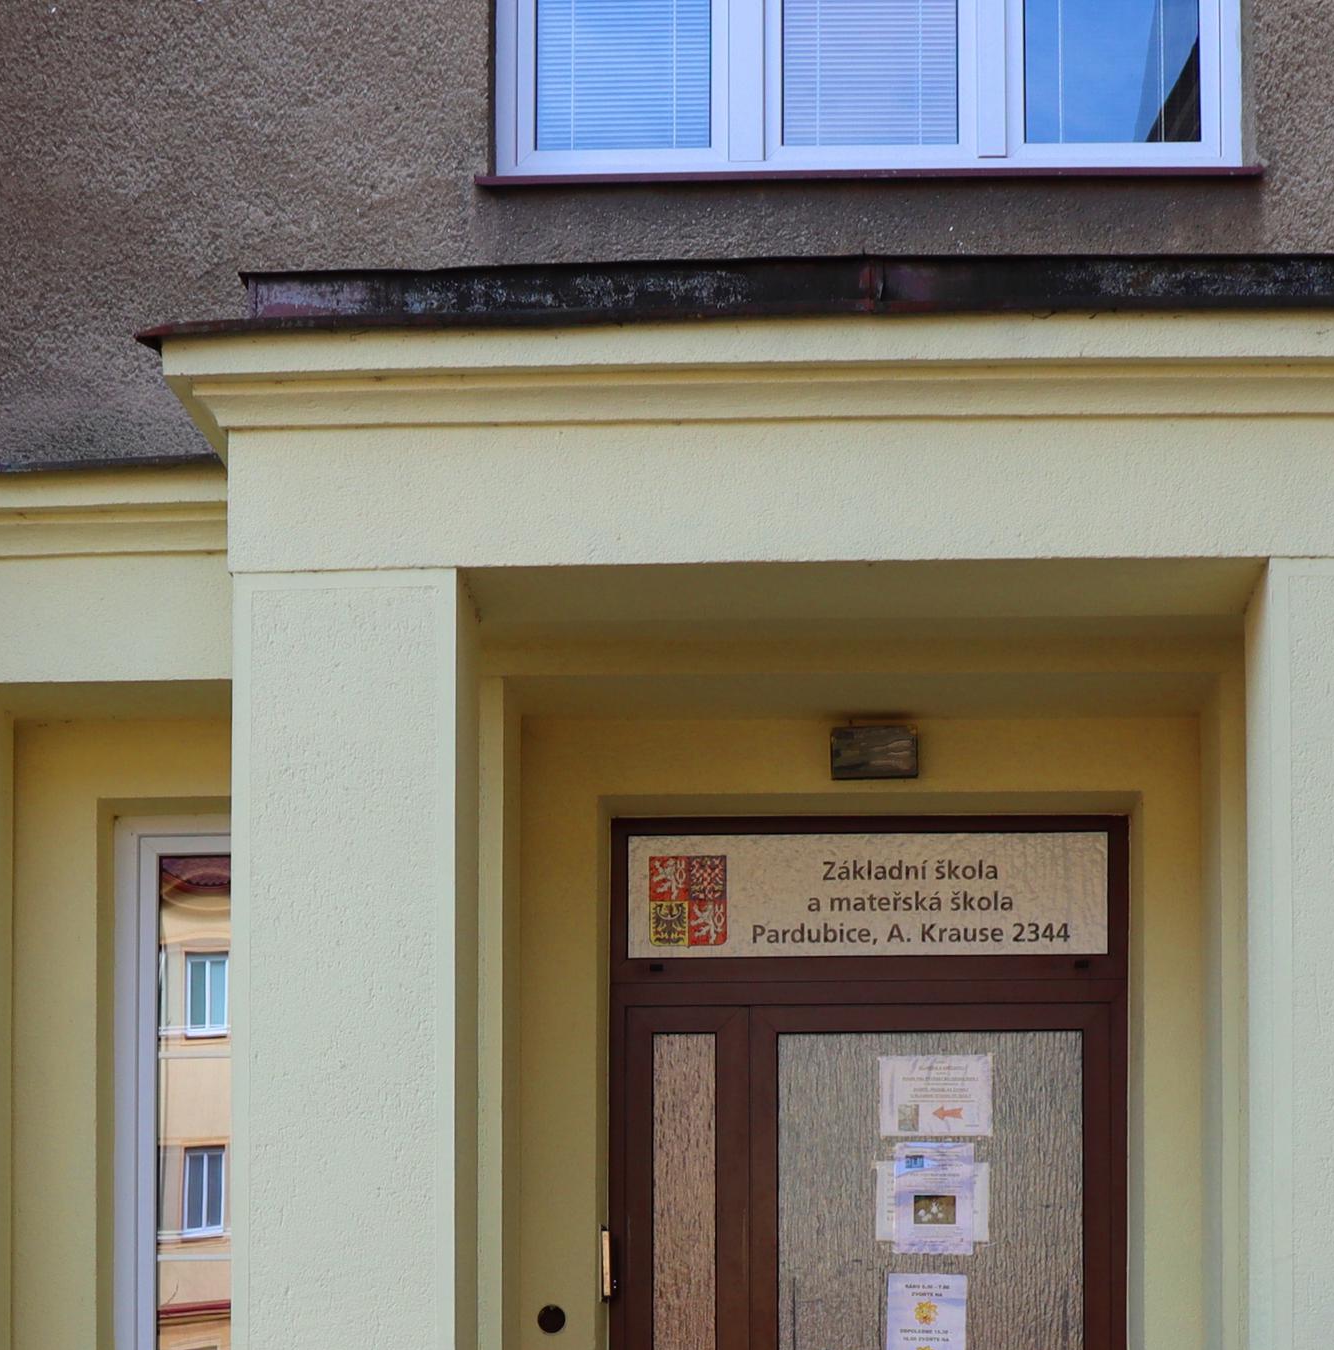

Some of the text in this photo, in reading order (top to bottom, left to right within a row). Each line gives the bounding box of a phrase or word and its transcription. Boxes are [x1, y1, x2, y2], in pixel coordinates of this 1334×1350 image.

[822, 859, 998, 881] Základní škola
[807, 890, 1014, 912] a mateřská škola
[752, 922, 1071, 946] Pardubice, A. Krause 2344
